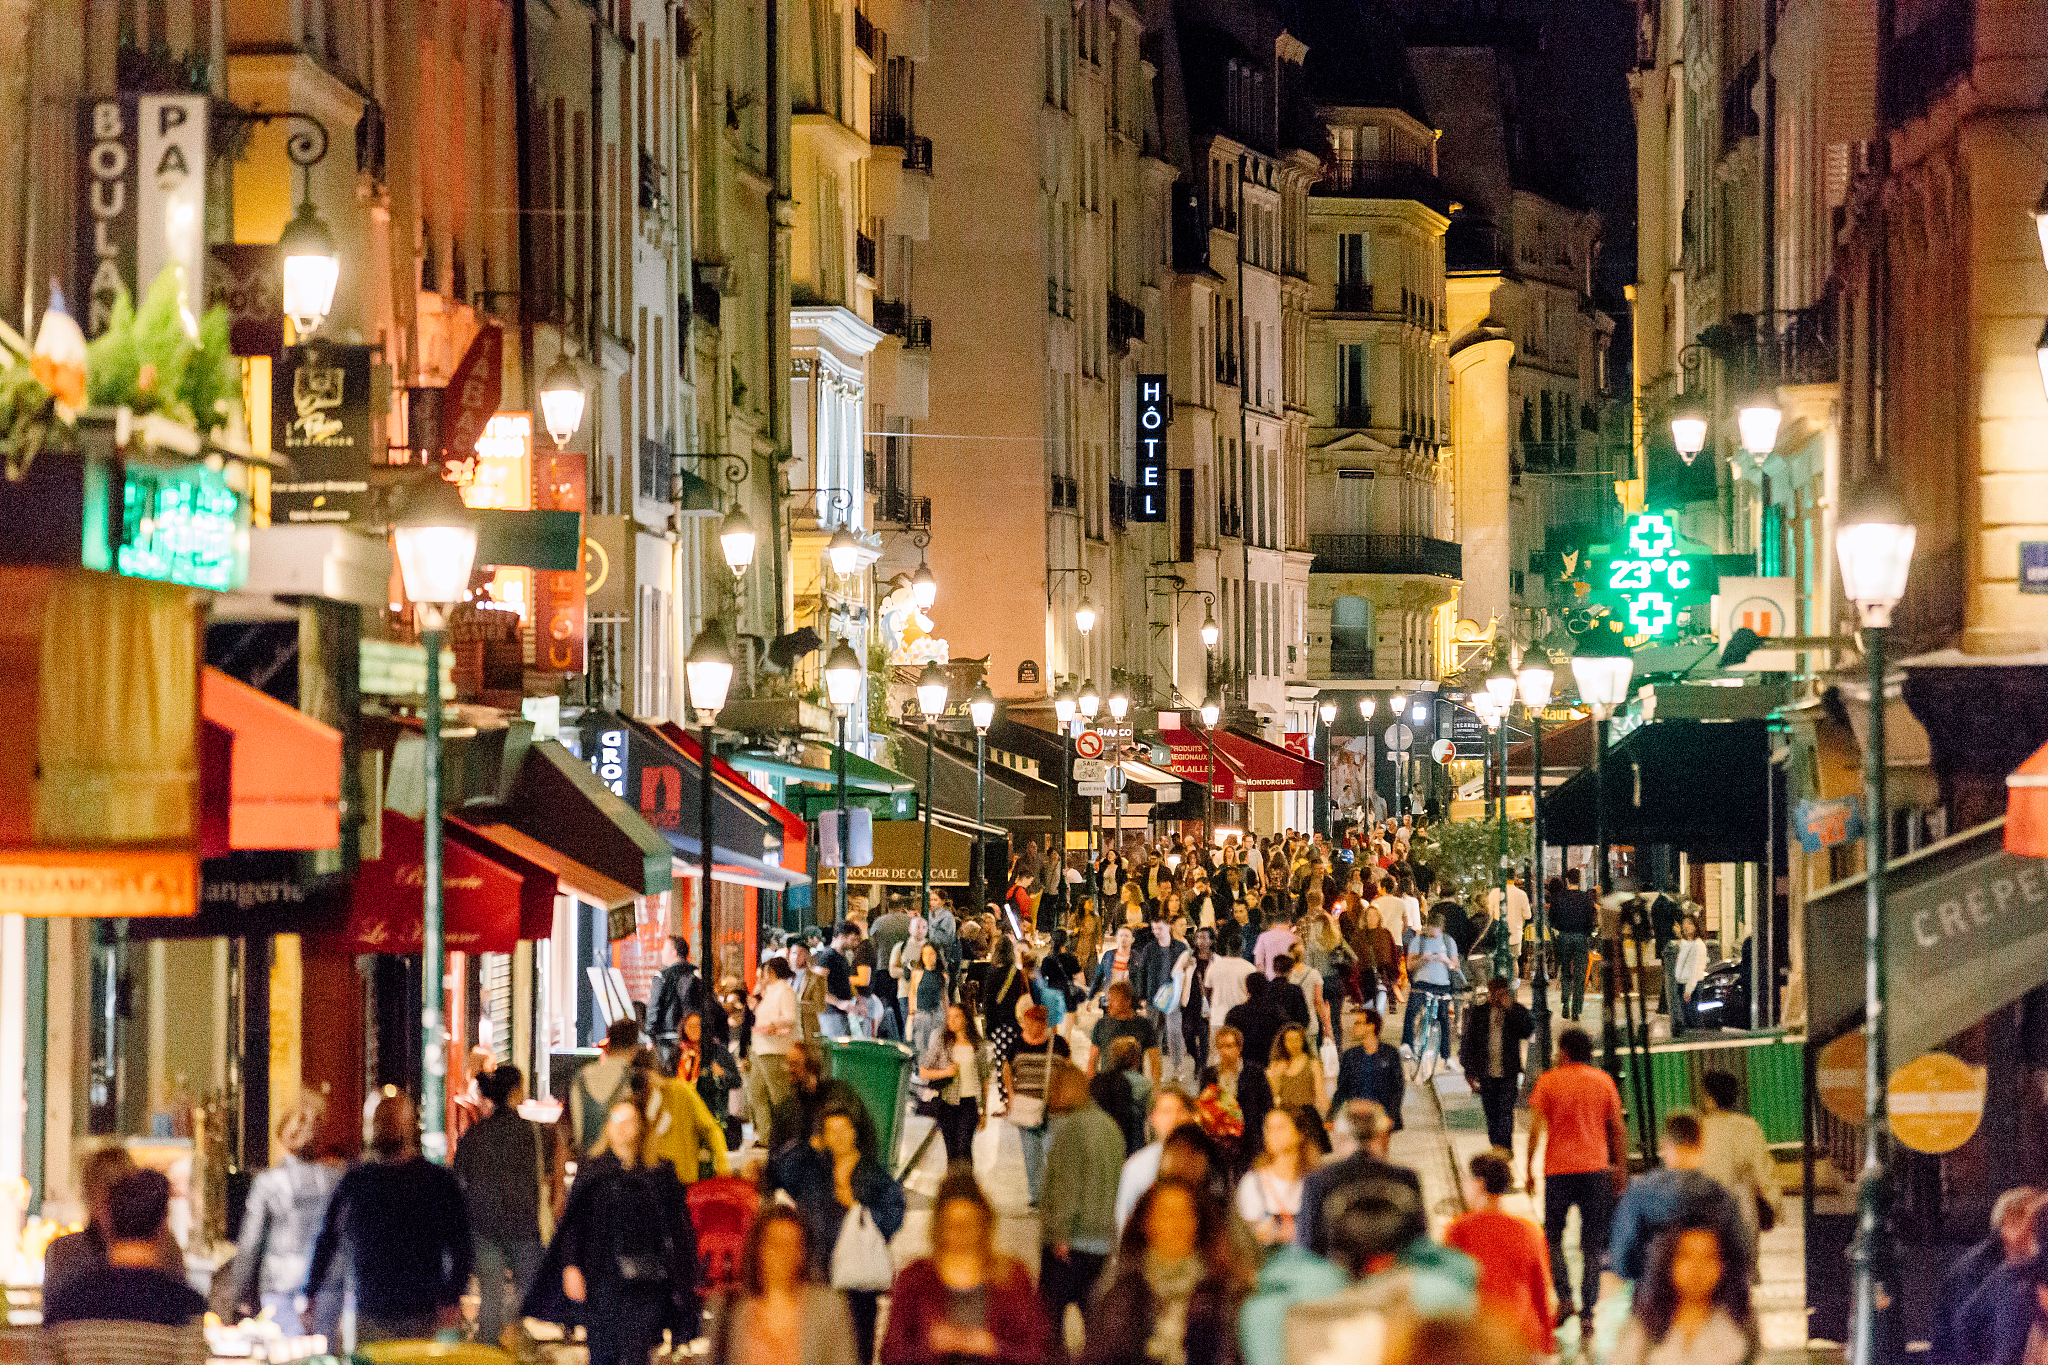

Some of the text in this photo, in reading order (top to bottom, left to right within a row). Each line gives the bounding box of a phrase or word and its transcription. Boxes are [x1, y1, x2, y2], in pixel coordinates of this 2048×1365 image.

[1142, 382, 1161, 514] HÔTEL
[1609, 559, 1690, 588] 23°C
[1246, 778, 1295, 786] MONTORGUEIL
[847, 867, 889, 878] ROCHER
[891, 868, 906, 879] DE
[907, 868, 958, 879] CACALE
